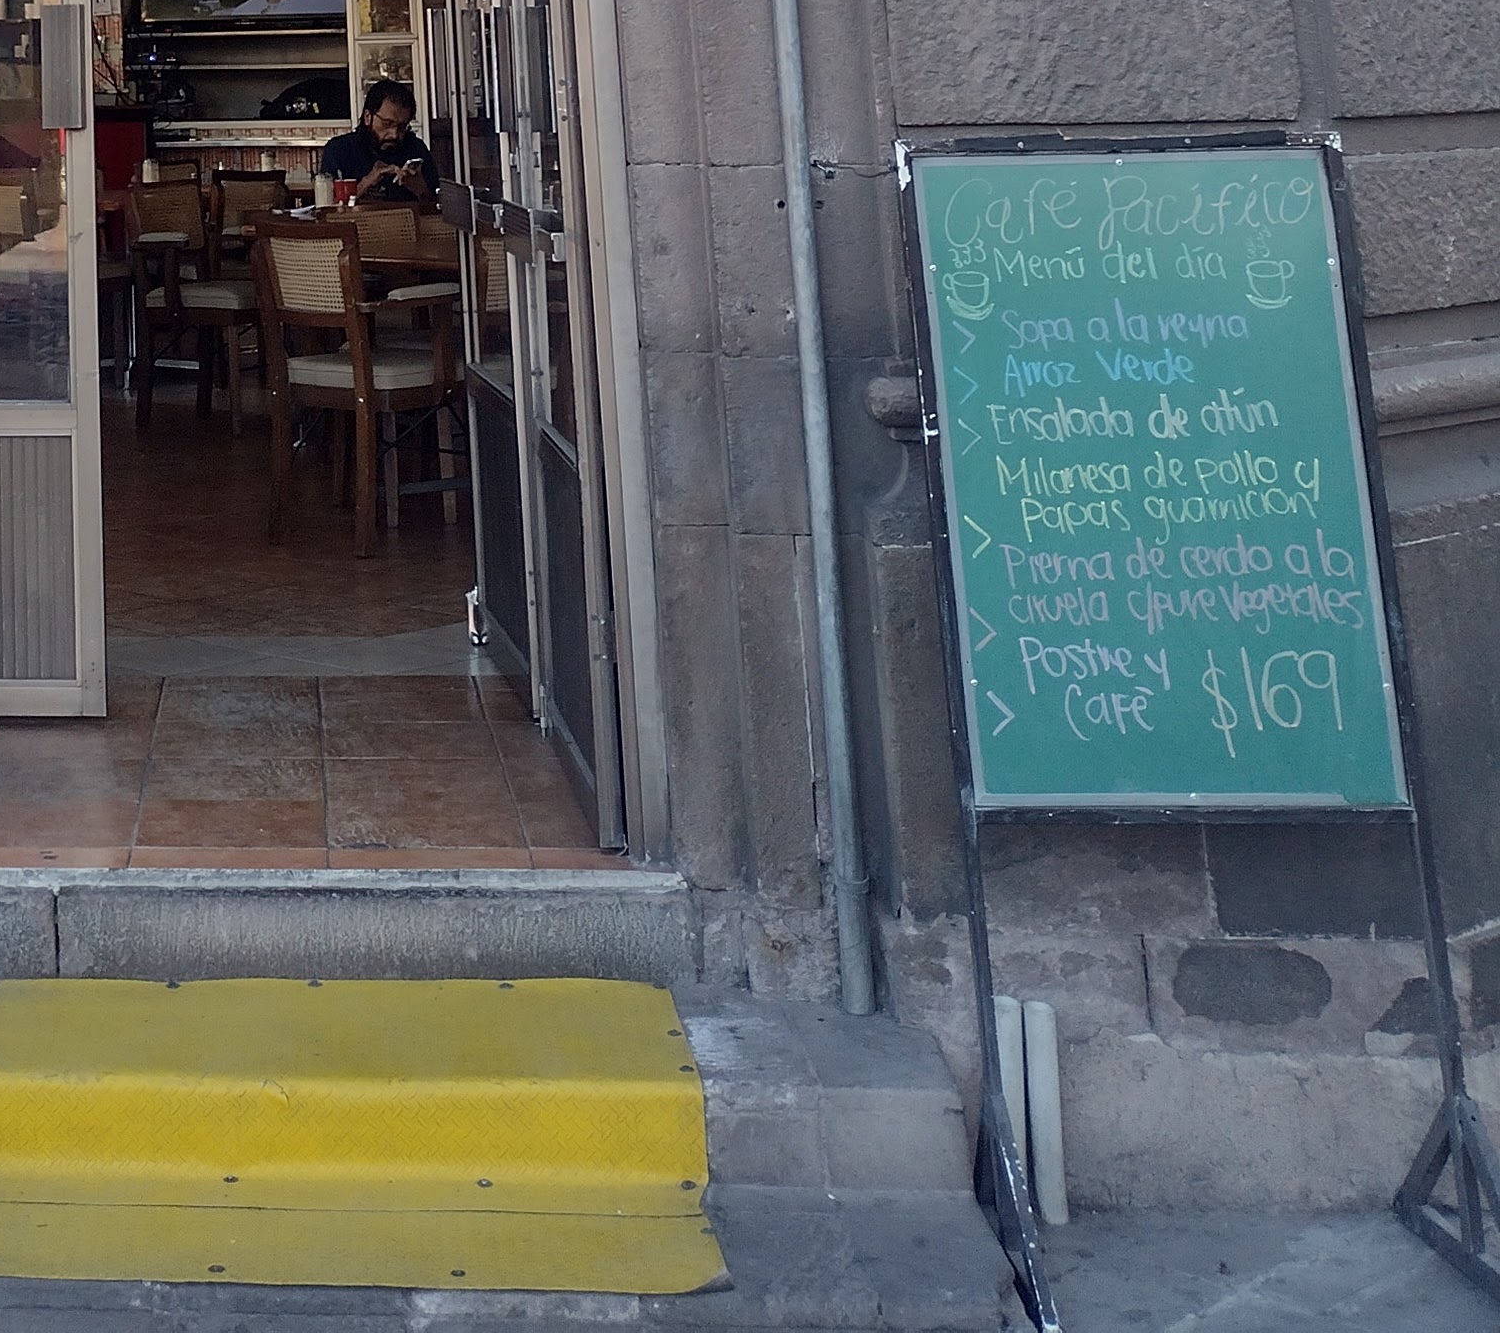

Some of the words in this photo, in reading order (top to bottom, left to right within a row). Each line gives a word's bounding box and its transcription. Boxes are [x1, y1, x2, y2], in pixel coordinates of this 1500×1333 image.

[945, 179, 1081, 247] Café
[993, 246, 1086, 287] Menú
[1103, 240, 1158, 284] del
[1176, 243, 1228, 280] día
[1001, 310, 1076, 352] Sopa
[1087, 317, 1112, 343] a
[1114, 297, 1151, 344] la
[1003, 353, 1082, 398] Arroz
[1095, 347, 1195, 386] Verde
[986, 396, 1134, 445] Ensalada
[1147, 393, 1191, 440] de
[1201, 386, 1279, 436] atún
[996, 454, 1132, 497] Milanesa
[1144, 450, 1187, 489] de
[1294, 457, 1320, 502] y
[999, 543, 1115, 589] Pierna
[1125, 536, 1173, 579] de
[1179, 534, 1273, 579] cerdo
[1284, 543, 1314, 579] a
[1315, 528, 1356, 584] la
[1008, 587, 1110, 626] ciruela
[1019, 636, 1136, 695] Postre
[1143, 647, 1171, 691] y
[1201, 646, 1344, 758] $169
